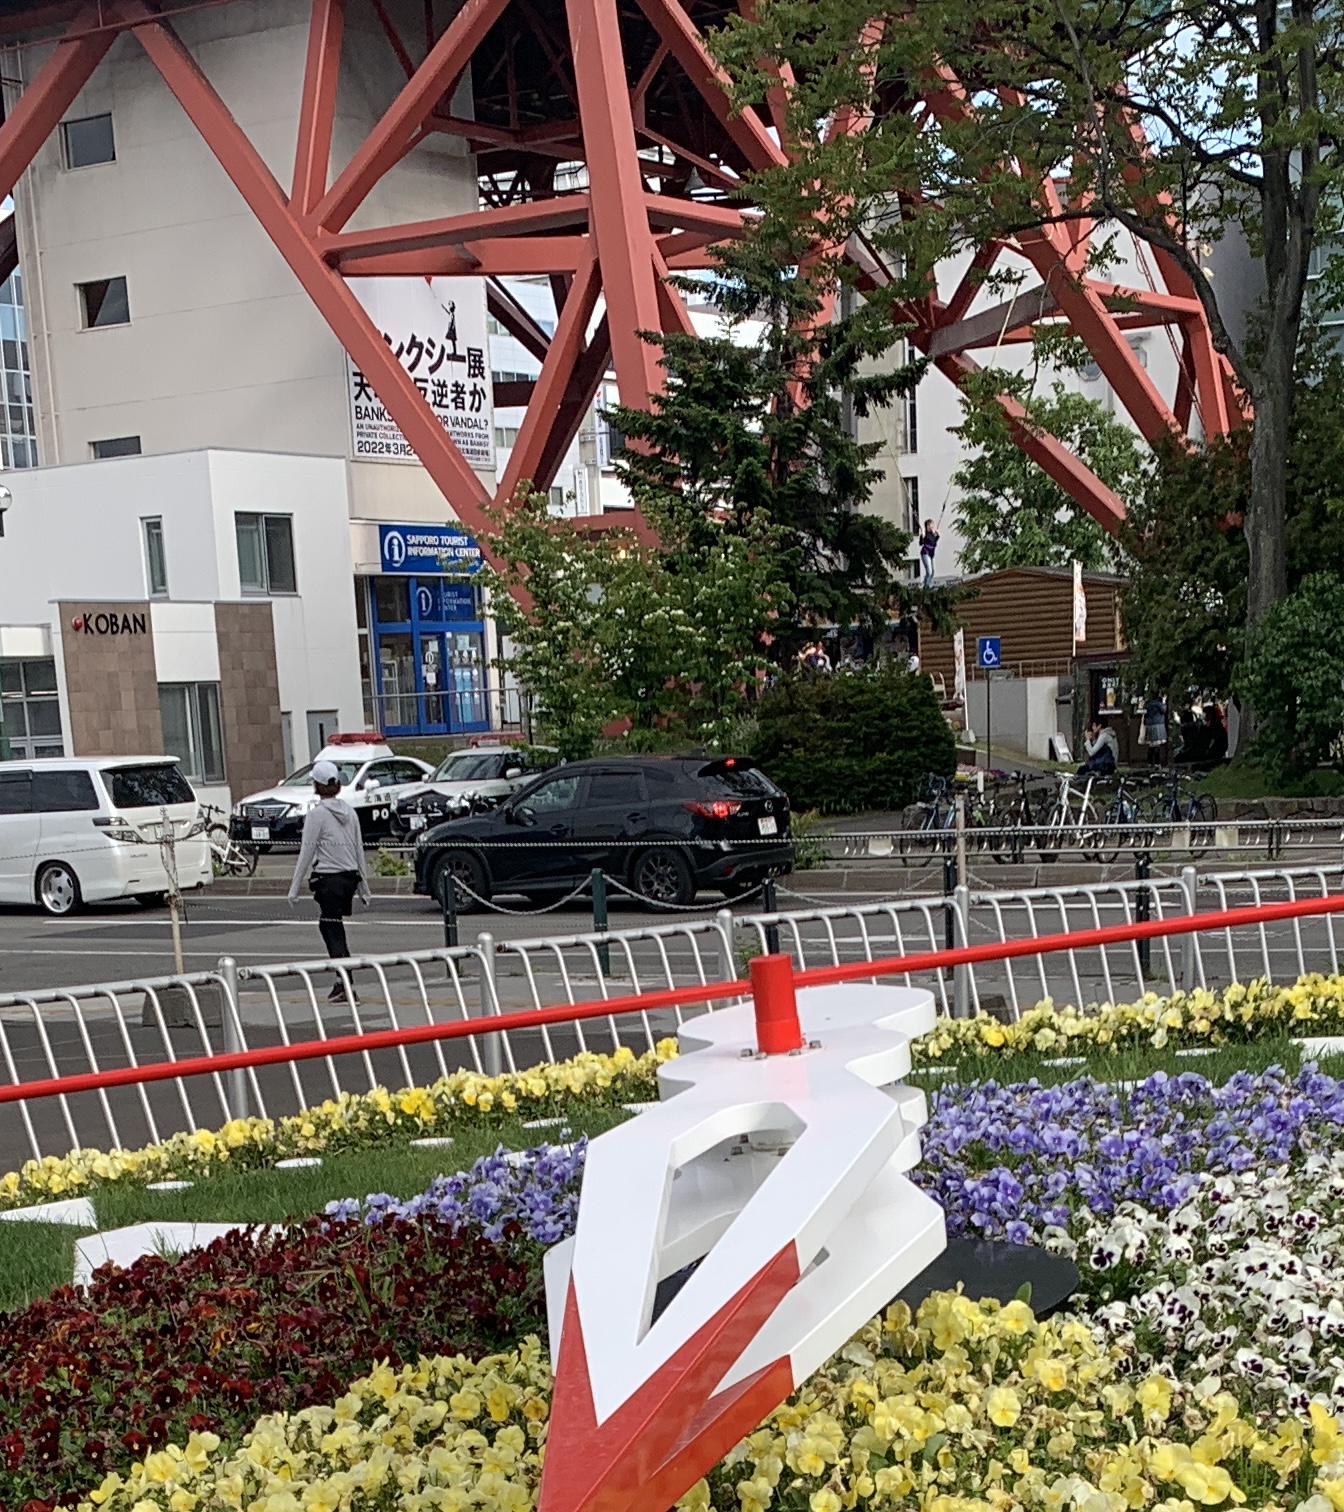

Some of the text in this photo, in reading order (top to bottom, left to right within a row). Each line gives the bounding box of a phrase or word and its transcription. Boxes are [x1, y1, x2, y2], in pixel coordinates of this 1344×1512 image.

[382, 332, 486, 380] ンクシー展
[352, 371, 487, 413] 天反逆者か
[449, 415, 489, 430] VANDAL?
[357, 440, 415, 456] 2022年3月2
[406, 534, 468, 546] SAPPORO TOURIST
[407, 546, 481, 557] INFORMATION CENTER
[83, 613, 146, 635] KOBAN
